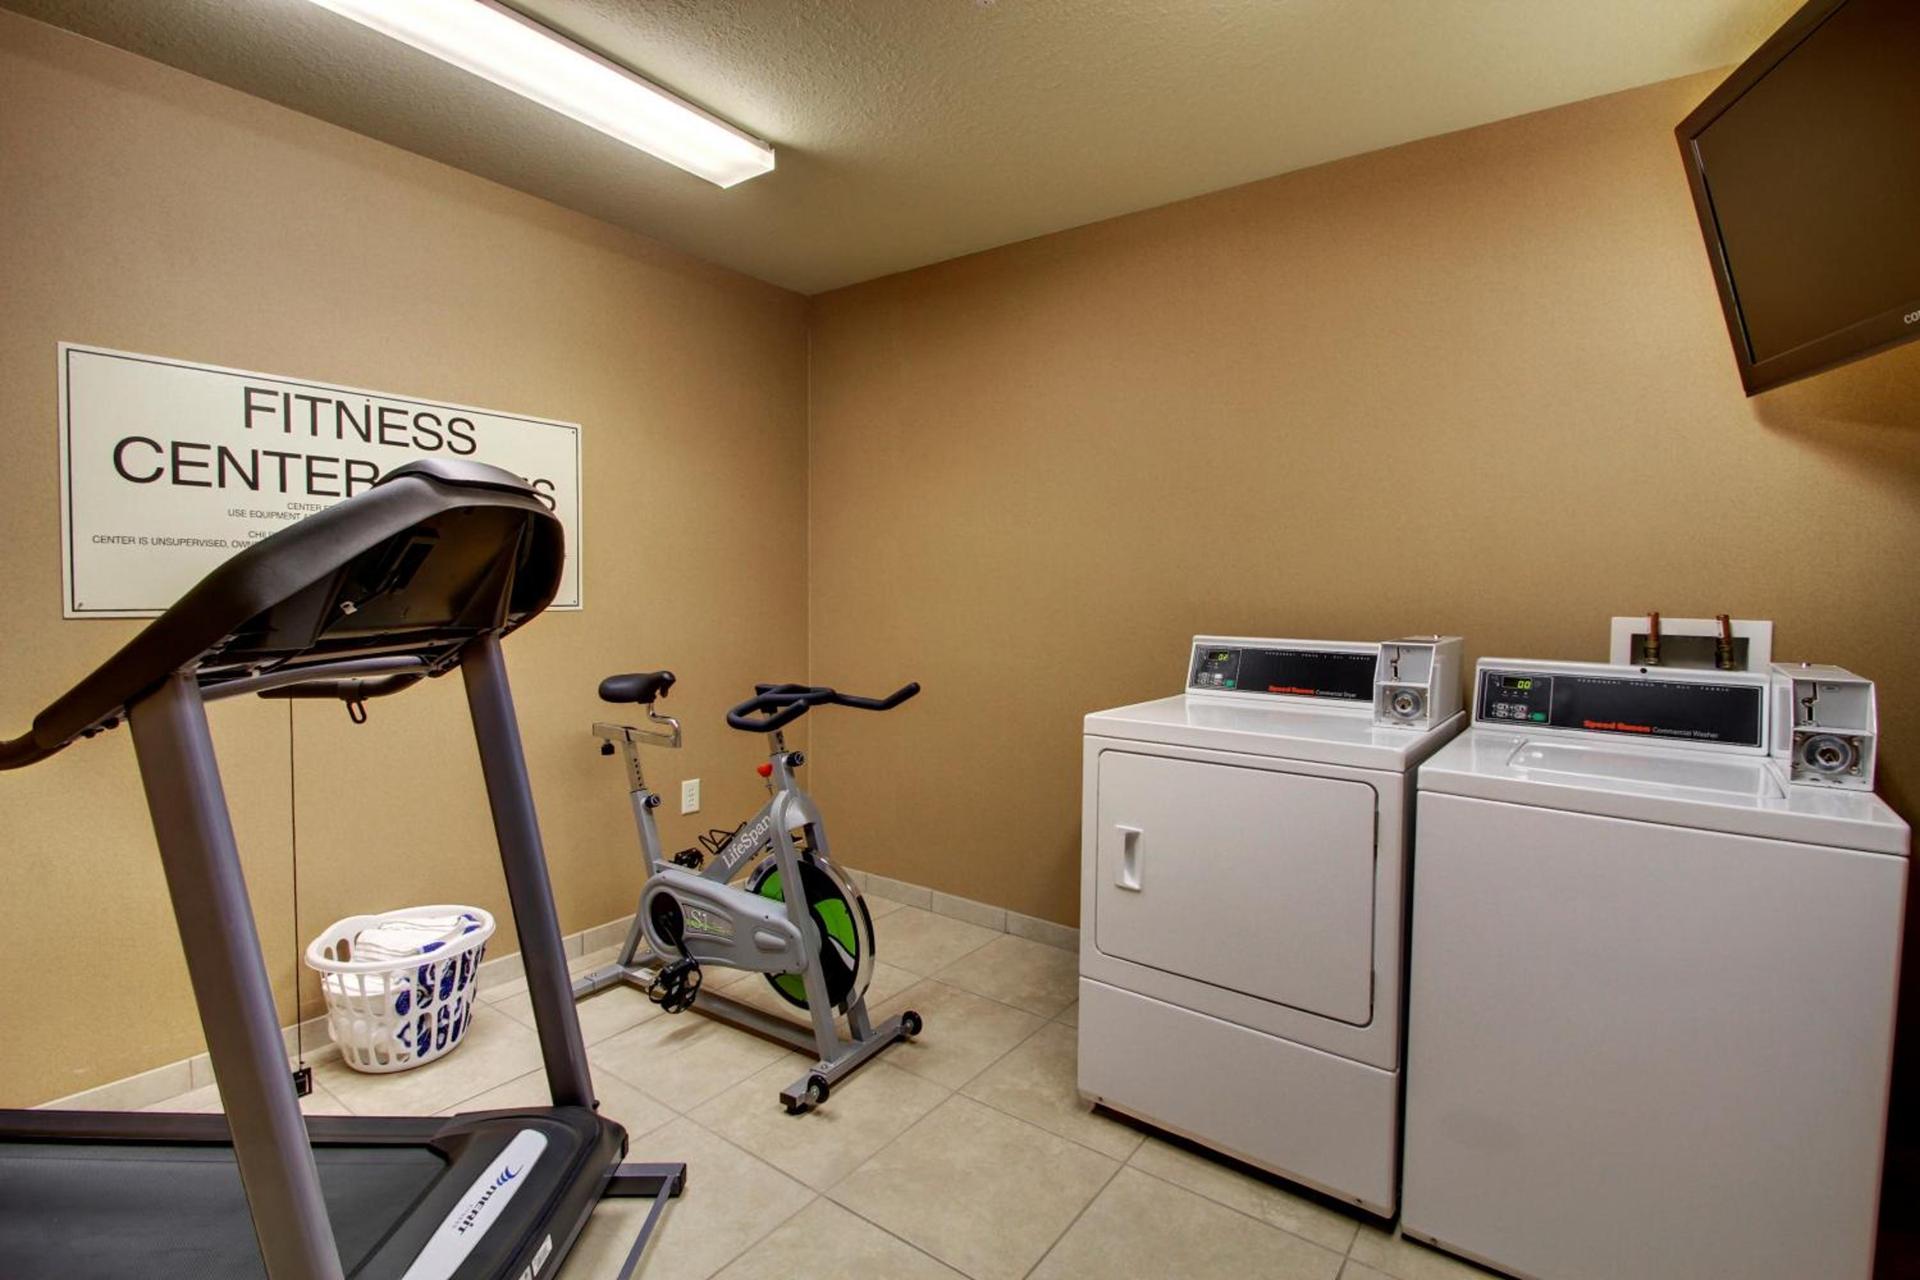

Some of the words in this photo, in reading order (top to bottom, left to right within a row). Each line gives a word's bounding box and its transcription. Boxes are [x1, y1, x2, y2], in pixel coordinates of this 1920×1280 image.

[244, 386, 477, 456] FITNESS
[113, 435, 381, 498] CENTER
[227, 508, 247, 518] USE
[249, 509, 301, 521] EQUIPMENT
[287, 502, 322, 512] CENTER
[92, 534, 136, 545] CENTER
[138, 536, 149, 546] IS
[151, 537, 230, 549] UNSUPERVISED,
[722, 815, 770, 868] LifeSpan
